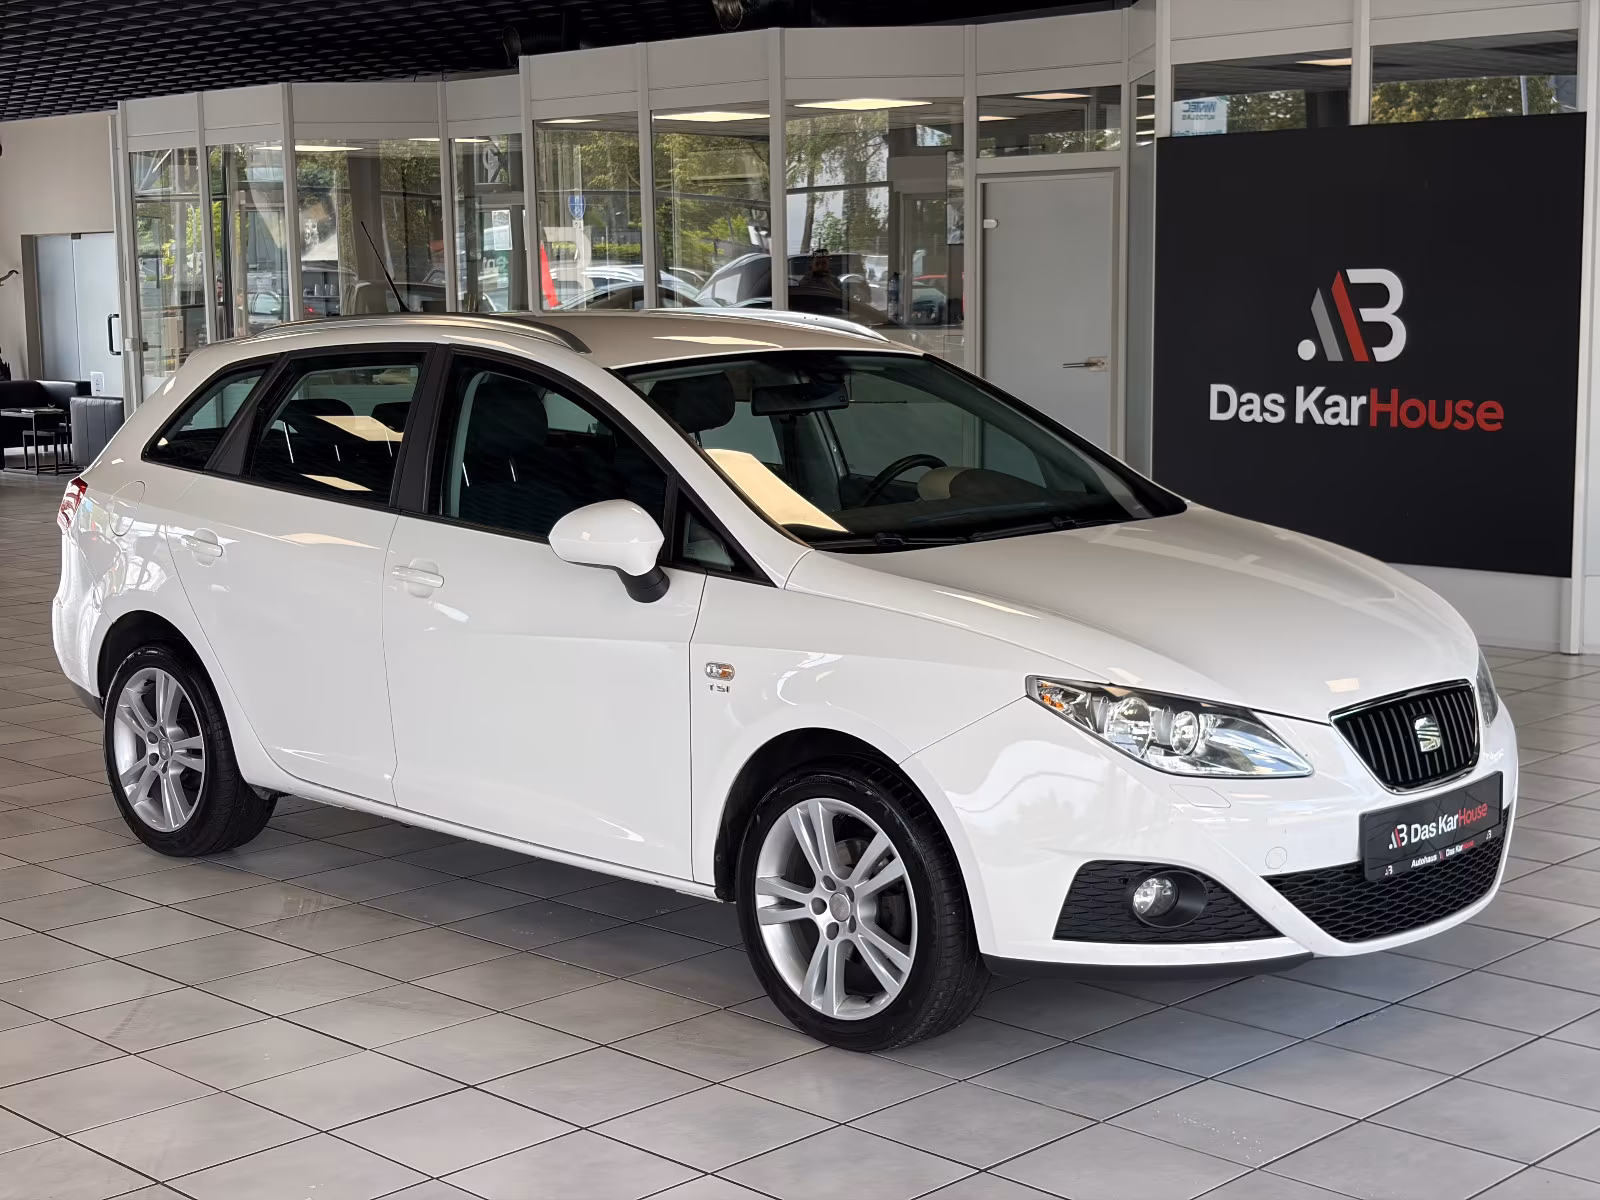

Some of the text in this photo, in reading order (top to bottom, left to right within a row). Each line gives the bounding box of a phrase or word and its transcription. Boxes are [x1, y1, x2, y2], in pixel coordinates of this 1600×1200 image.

[1209, 383, 1286, 424] Das
[1410, 821, 1437, 844] Das
[1410, 854, 1437, 868] Autohaus
